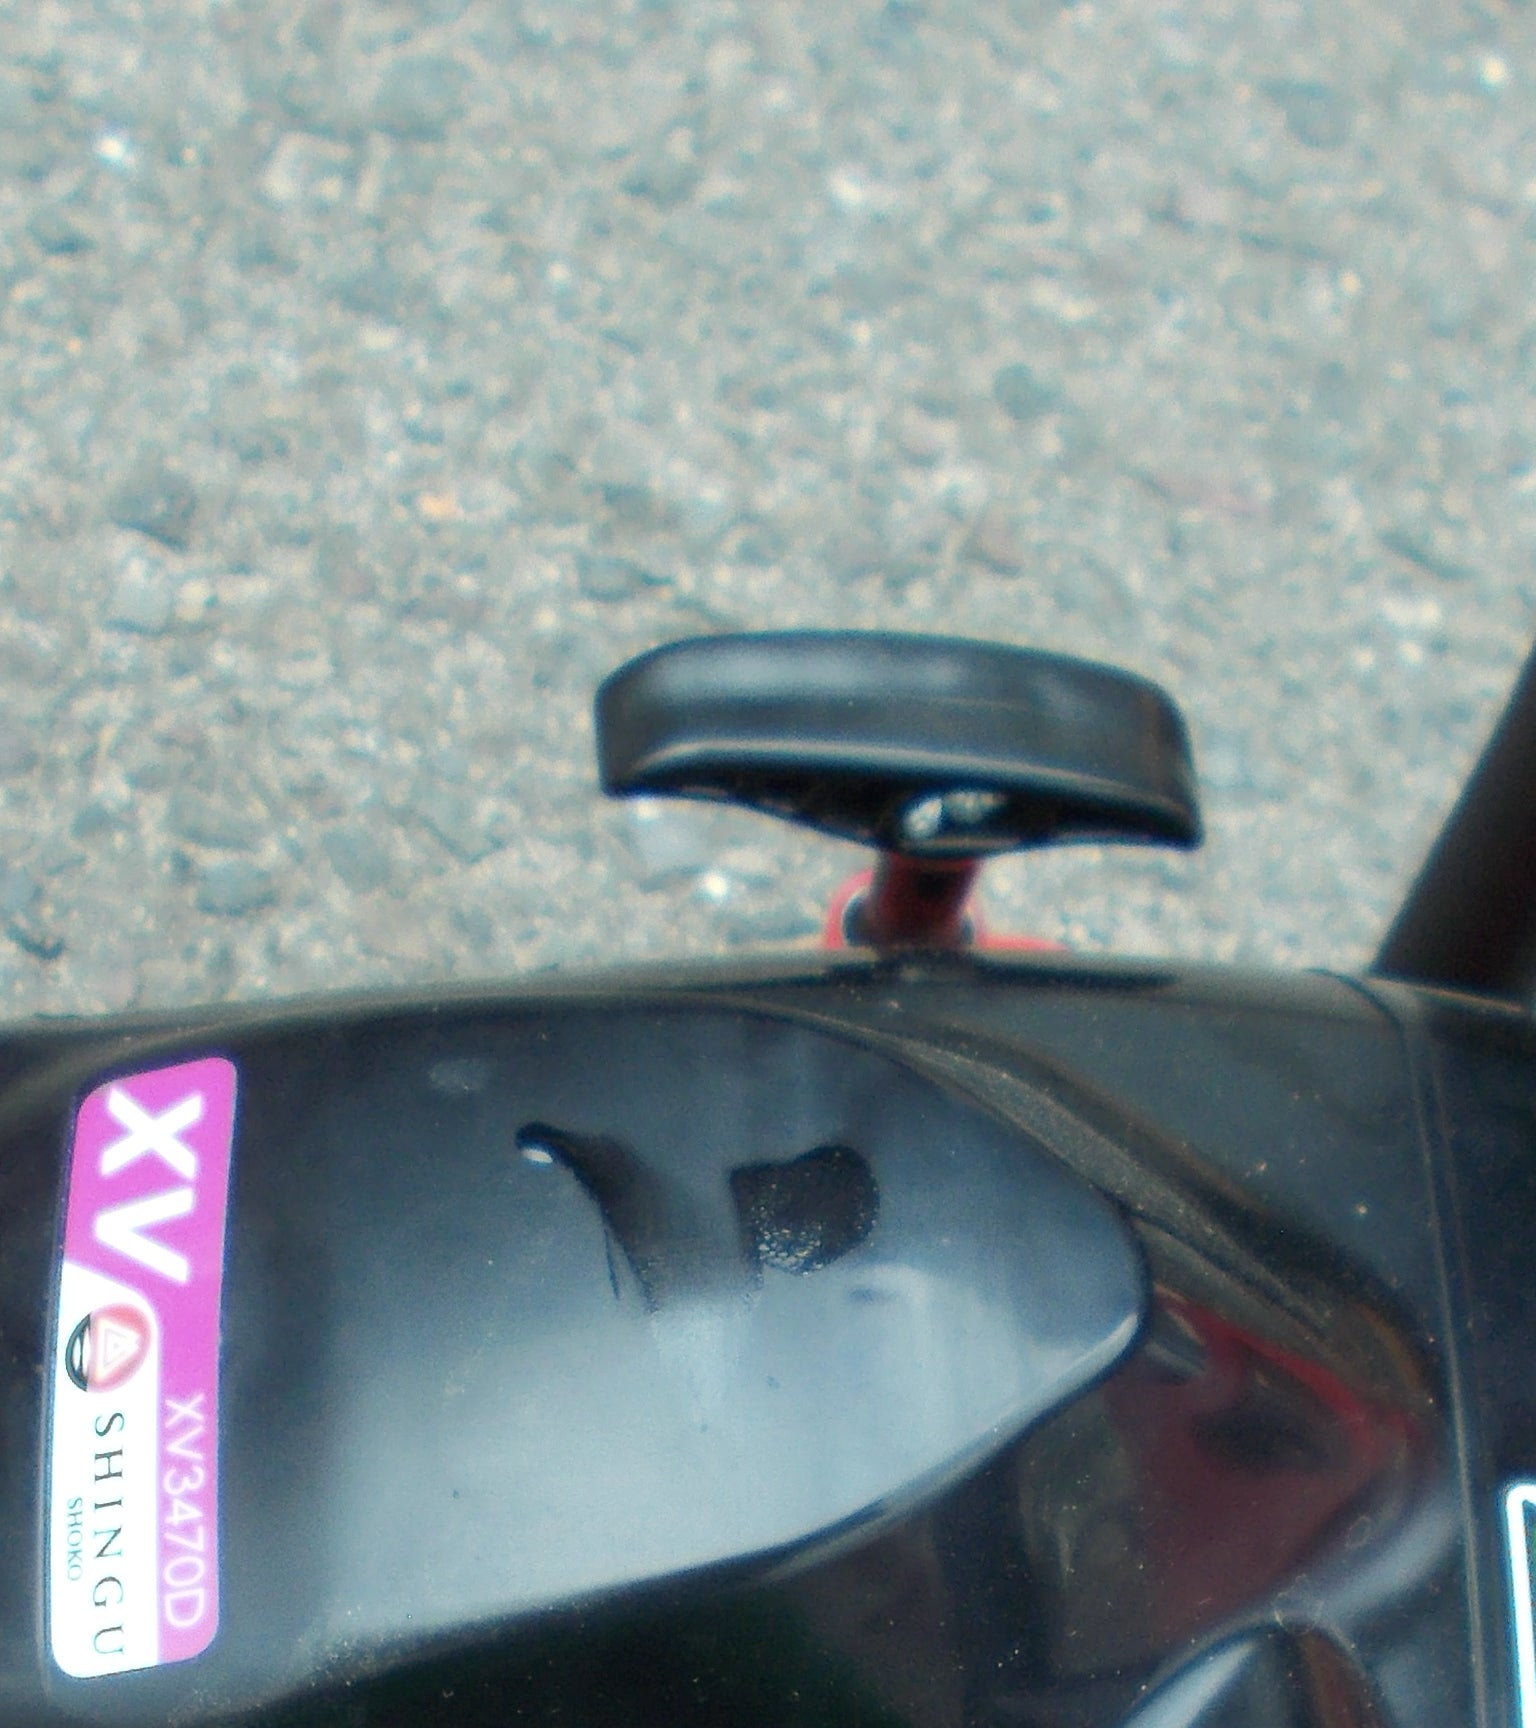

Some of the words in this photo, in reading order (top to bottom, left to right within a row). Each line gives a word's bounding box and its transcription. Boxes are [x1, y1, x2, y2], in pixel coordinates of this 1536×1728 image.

[94, 1084, 204, 1285] XV
[66, 1496, 84, 1582] SHOKO
[92, 1411, 126, 1656] SHINGU
[163, 1392, 206, 1629] XV3470D
